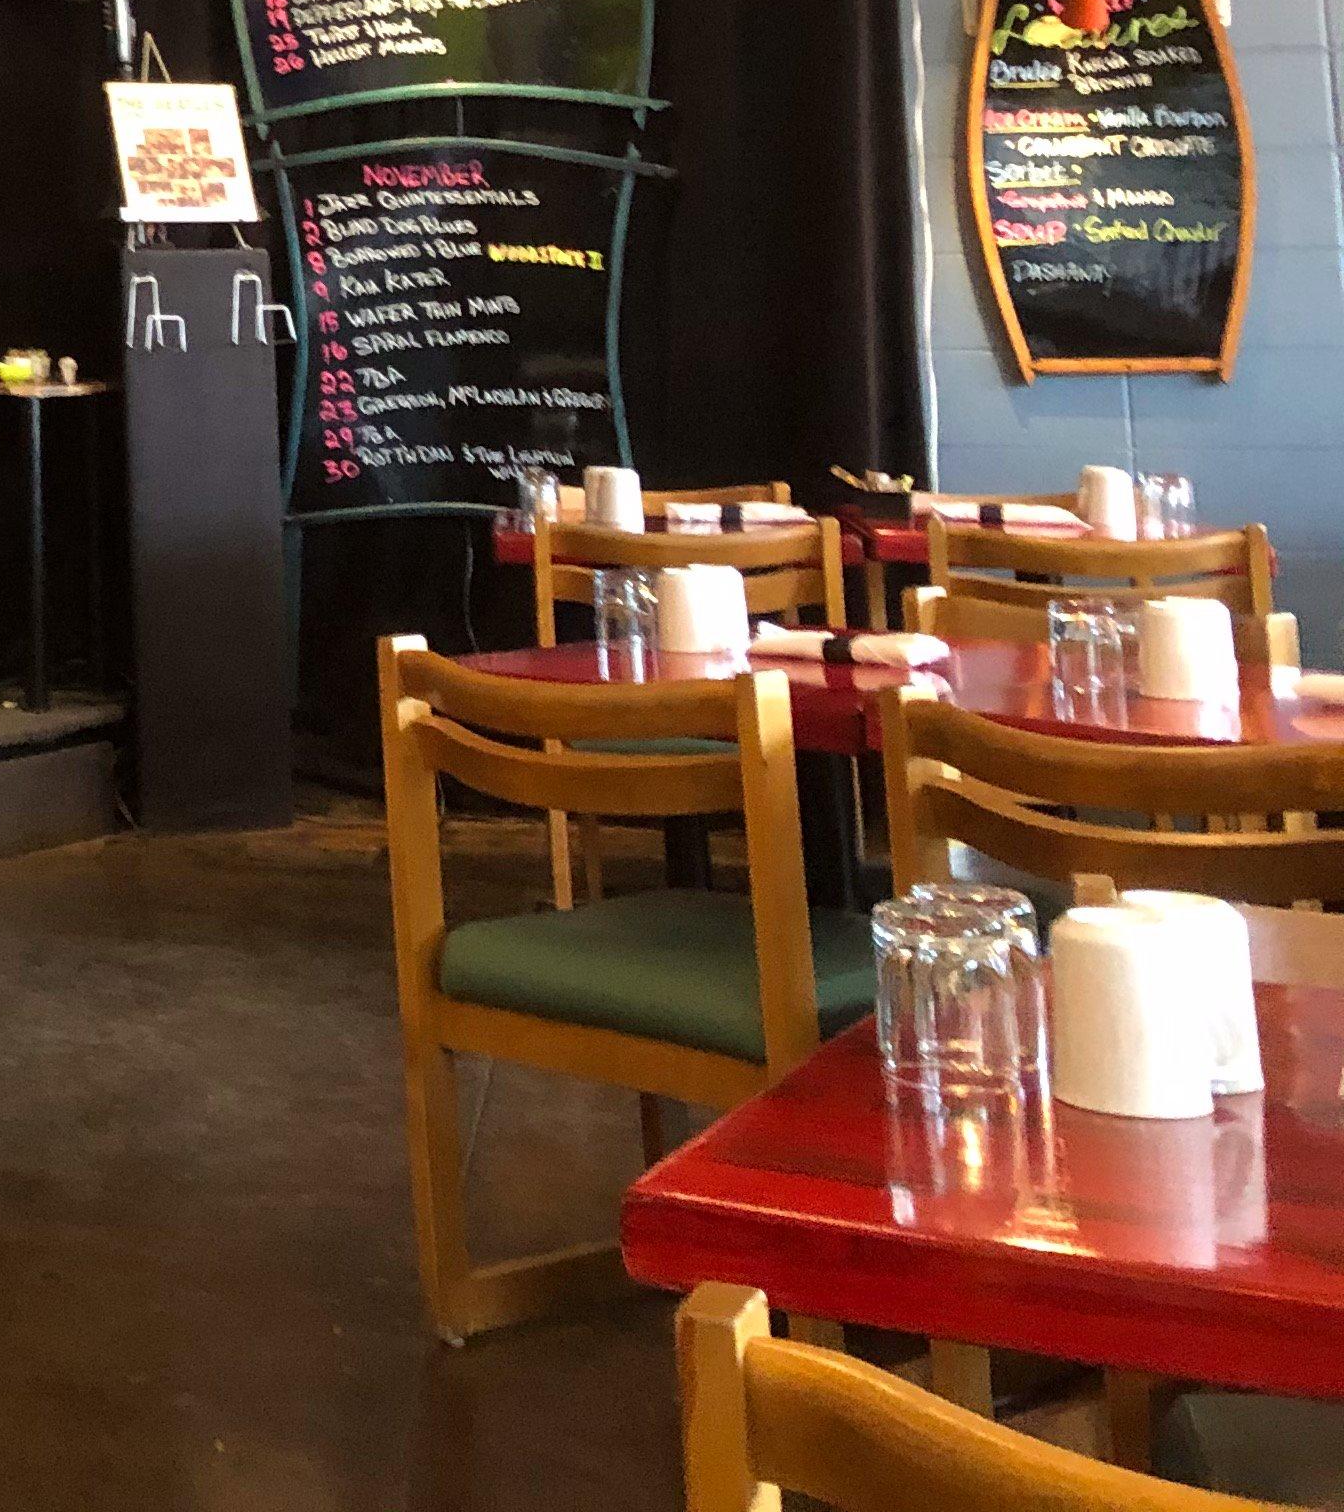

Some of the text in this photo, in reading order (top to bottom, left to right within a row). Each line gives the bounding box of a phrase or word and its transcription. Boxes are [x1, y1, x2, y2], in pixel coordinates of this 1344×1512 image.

[363, 159, 490, 187] NOVEMBER
[343, 303, 419, 327] WAFER
[417, 300, 462, 320] THIN
[319, 369, 356, 395] 22
[322, 459, 360, 484] 30
